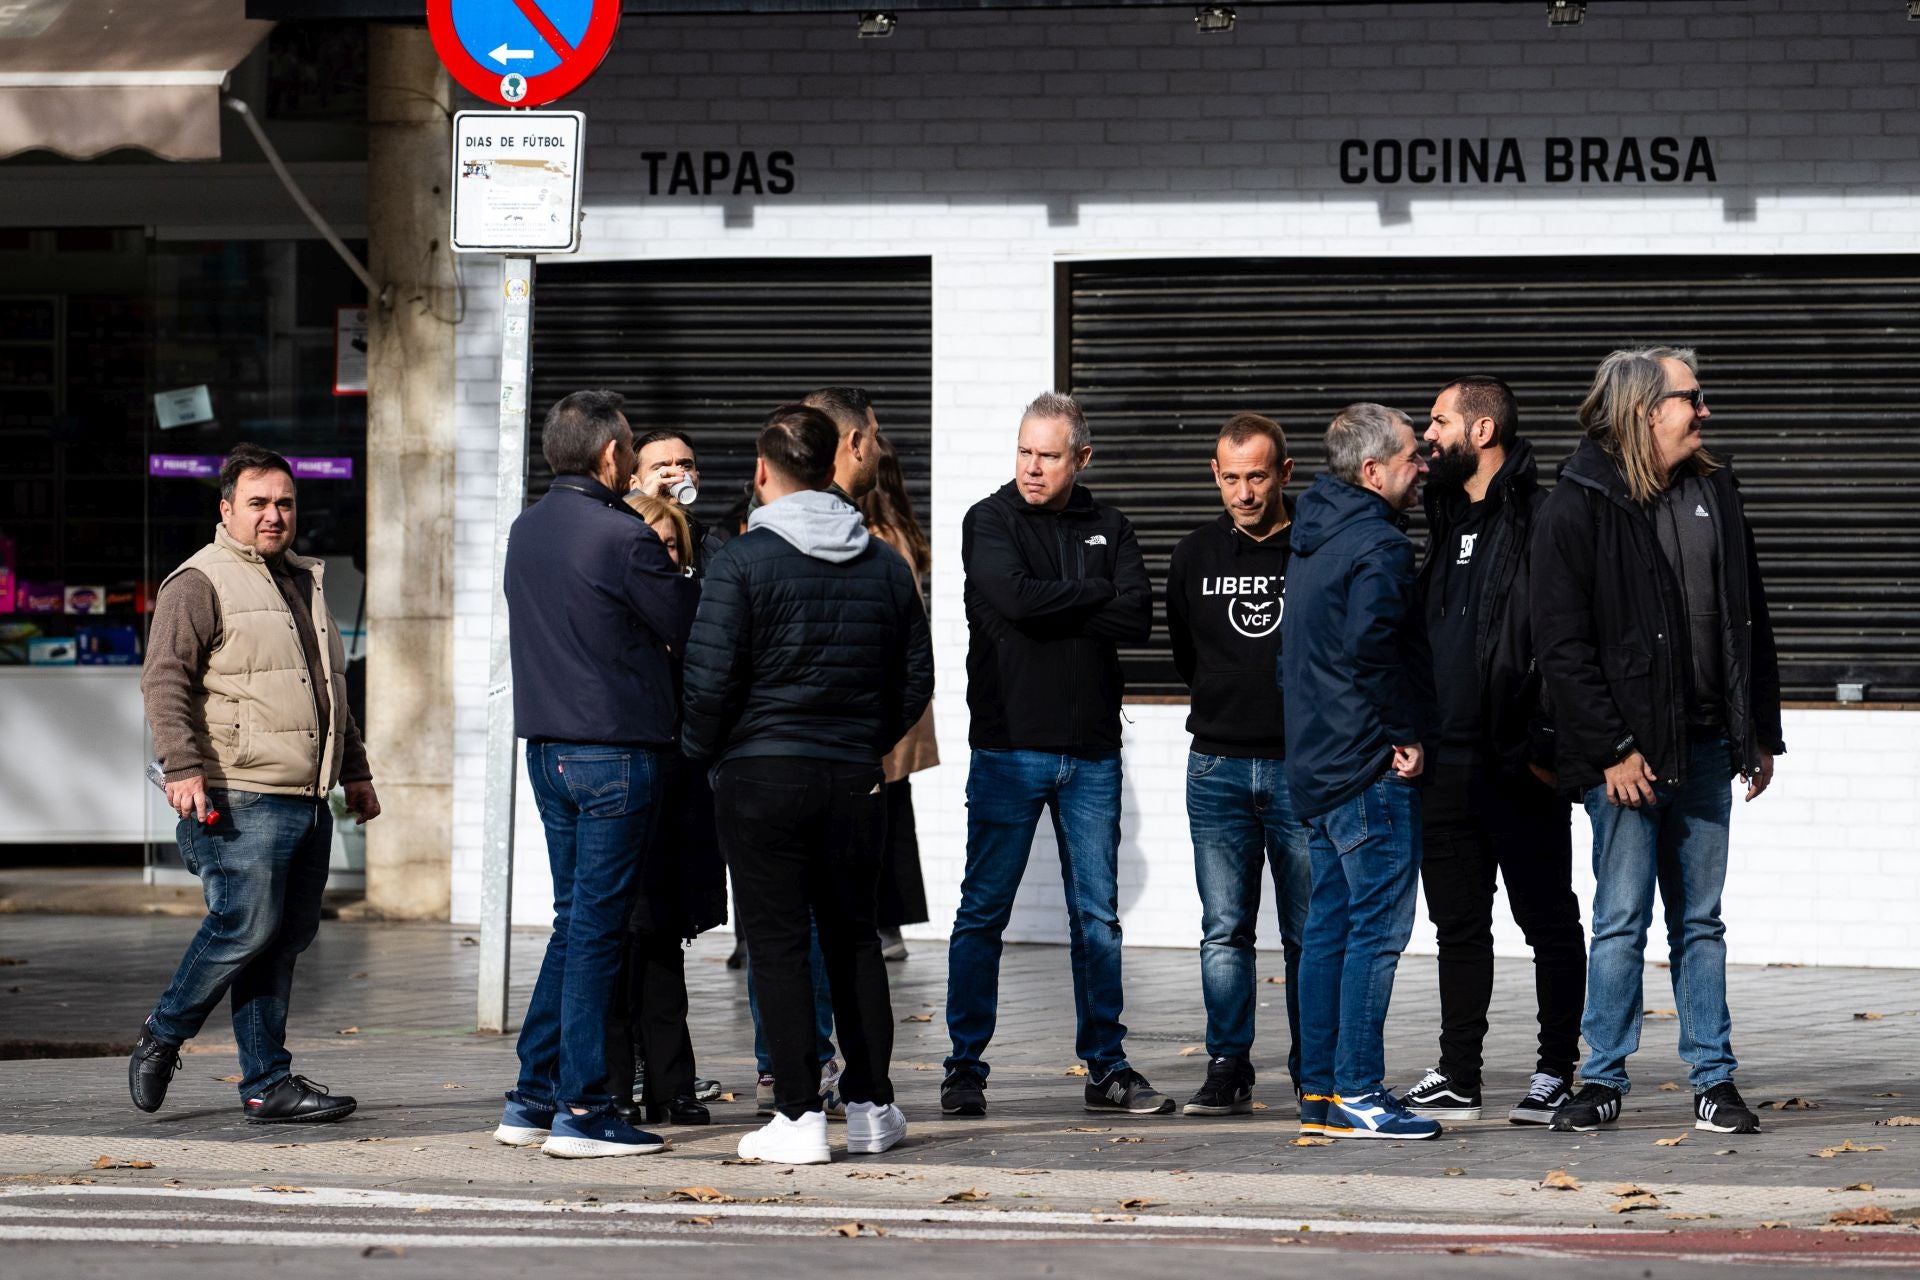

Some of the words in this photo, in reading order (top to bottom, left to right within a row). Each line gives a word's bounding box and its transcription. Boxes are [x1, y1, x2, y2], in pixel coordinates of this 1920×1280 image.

[465, 136, 492, 147] DIAS
[500, 136, 515, 147] DE
[522, 133, 565, 147] FÚTBOL
[640, 150, 795, 196] TAPAS
[1339, 137, 1527, 184] COCINA
[1544, 136, 1718, 183] BRASA
[1241, 613, 1272, 627] VCF
